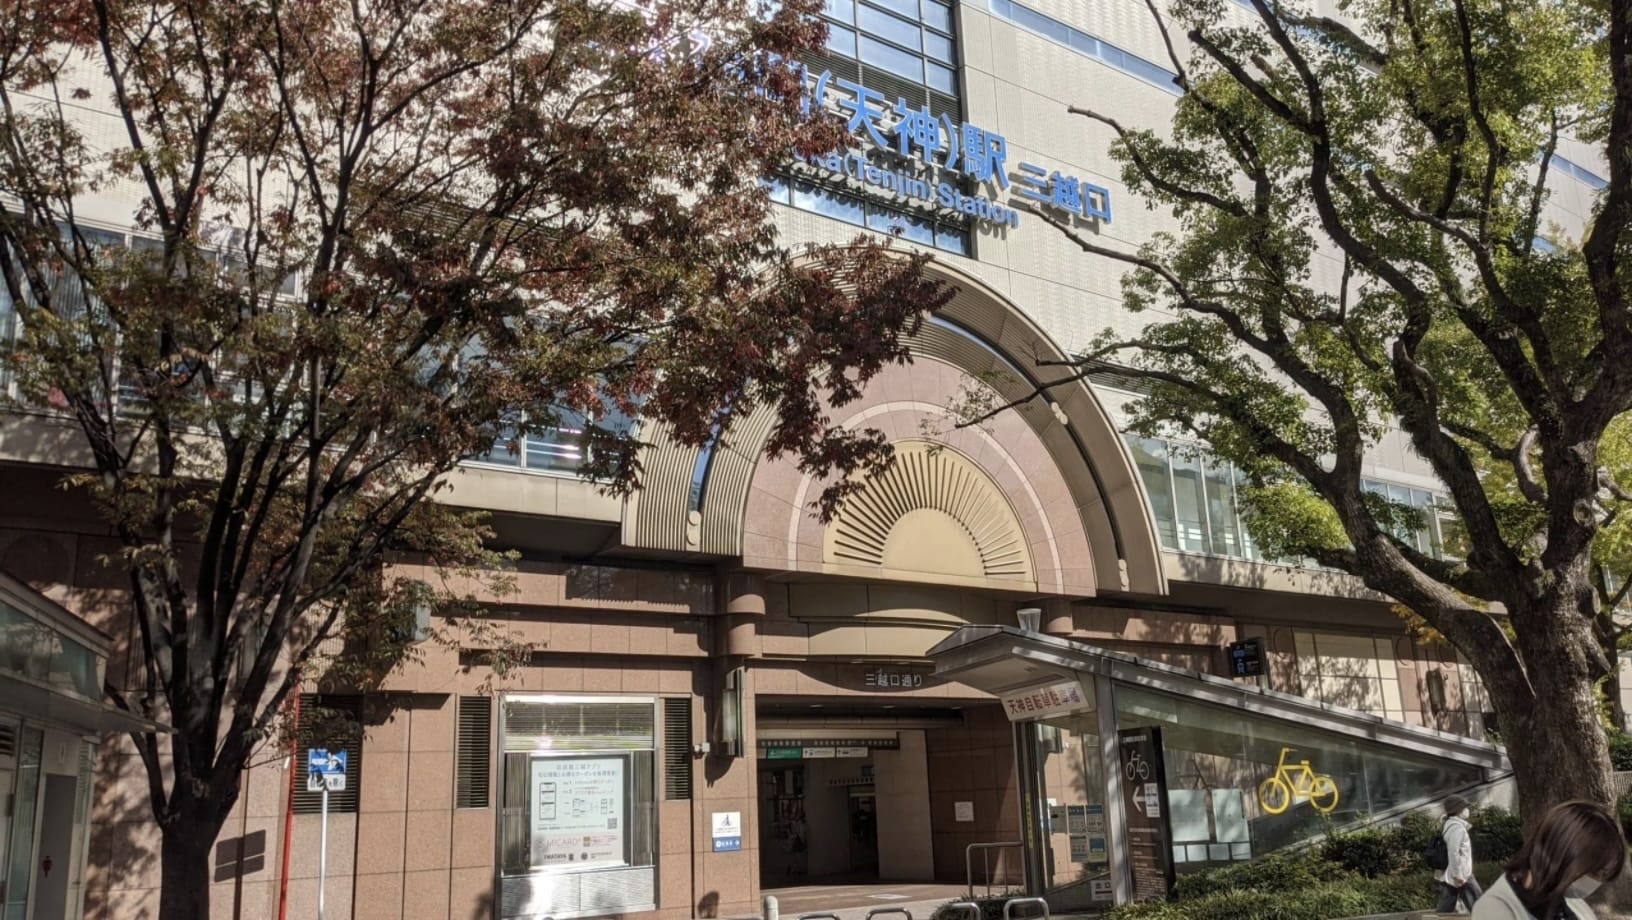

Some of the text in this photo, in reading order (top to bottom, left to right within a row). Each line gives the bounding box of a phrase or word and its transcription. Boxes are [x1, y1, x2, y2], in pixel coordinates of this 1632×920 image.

[937, 182, 1019, 229] Station
[1018, 161, 1111, 224] 三越口
[864, 669, 922, 687] 三越口通り
